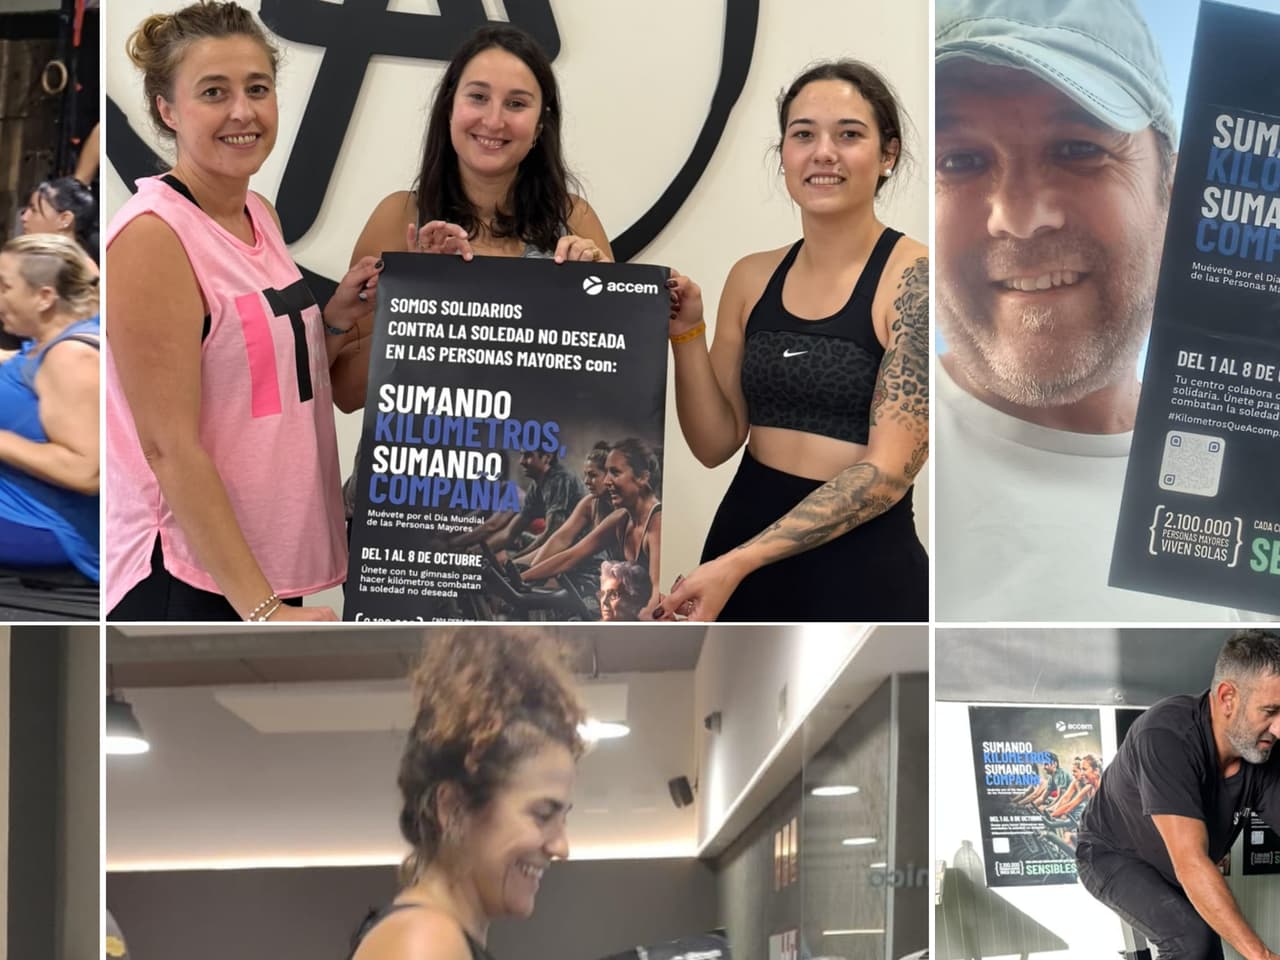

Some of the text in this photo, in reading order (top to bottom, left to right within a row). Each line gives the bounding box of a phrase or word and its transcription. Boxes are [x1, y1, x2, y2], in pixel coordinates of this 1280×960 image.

[1191, 272, 1203, 282] de
[1205, 273, 1220, 285] las
[1223, 275, 1267, 292] Personas
[1192, 262, 1233, 277] Muévete
[1235, 269, 1252, 281] por
[1254, 269, 1264, 281] el
[1266, 270, 1280, 284] Día
[607, 281, 658, 295] accem
[390, 298, 522, 319] SOMOS SOLIDARIOS
[388, 320, 625, 350] CONTRA LA SOLEDAD NO DESEADA
[386, 343, 617, 373] EN LAS PERSONAS MAYORES con:
[1177, 350, 1205, 371] DEL
[1209, 355, 1216, 372] 1
[1219, 356, 1238, 377] AL
[1243, 360, 1251, 378] 8
[1255, 362, 1275, 381] DE
[1175, 375, 1187, 384] Tu
[1190, 378, 1225, 391] centro
[1227, 384, 1273, 399] colabora
[378, 383, 511, 419] SUMANDO
[1173, 386, 1220, 401] solidaria.
[1223, 391, 1255, 407] Únete
[1256, 399, 1280, 412] para
[1171, 398, 1223, 412] combatan
[1226, 404, 1236, 414] la
[1239, 407, 1280, 422] soledad
[372, 445, 501, 482] SUMANDO
[367, 519, 473, 534] de las Personas Mayores
[368, 510, 485, 525] Muévete por el Día Mundial
[1164, 512, 1231, 537] 2.100.000
[1254, 520, 1272, 531] CADA
[1162, 530, 1229, 547] PERSONAS MAYORES
[362, 547, 482, 567] DEL 1 AL 8 DE OCTUBRE
[1161, 539, 1228, 562] VIVEN SOLAS
[360, 575, 481, 590] hacer kilómetros combatan
[361, 565, 384, 575] Únete
[404, 569, 414, 577] tu
[416, 569, 460, 581] gimnasio
[462, 573, 482, 582] para
[359, 584, 368, 592] la
[370, 585, 405, 594] soledad
[421, 588, 458, 598] deseada
[982, 742, 1032, 753] SUMANDO
[984, 764, 1032, 775] SUMANDO
[1025, 863, 1078, 875] SENSIBLES
